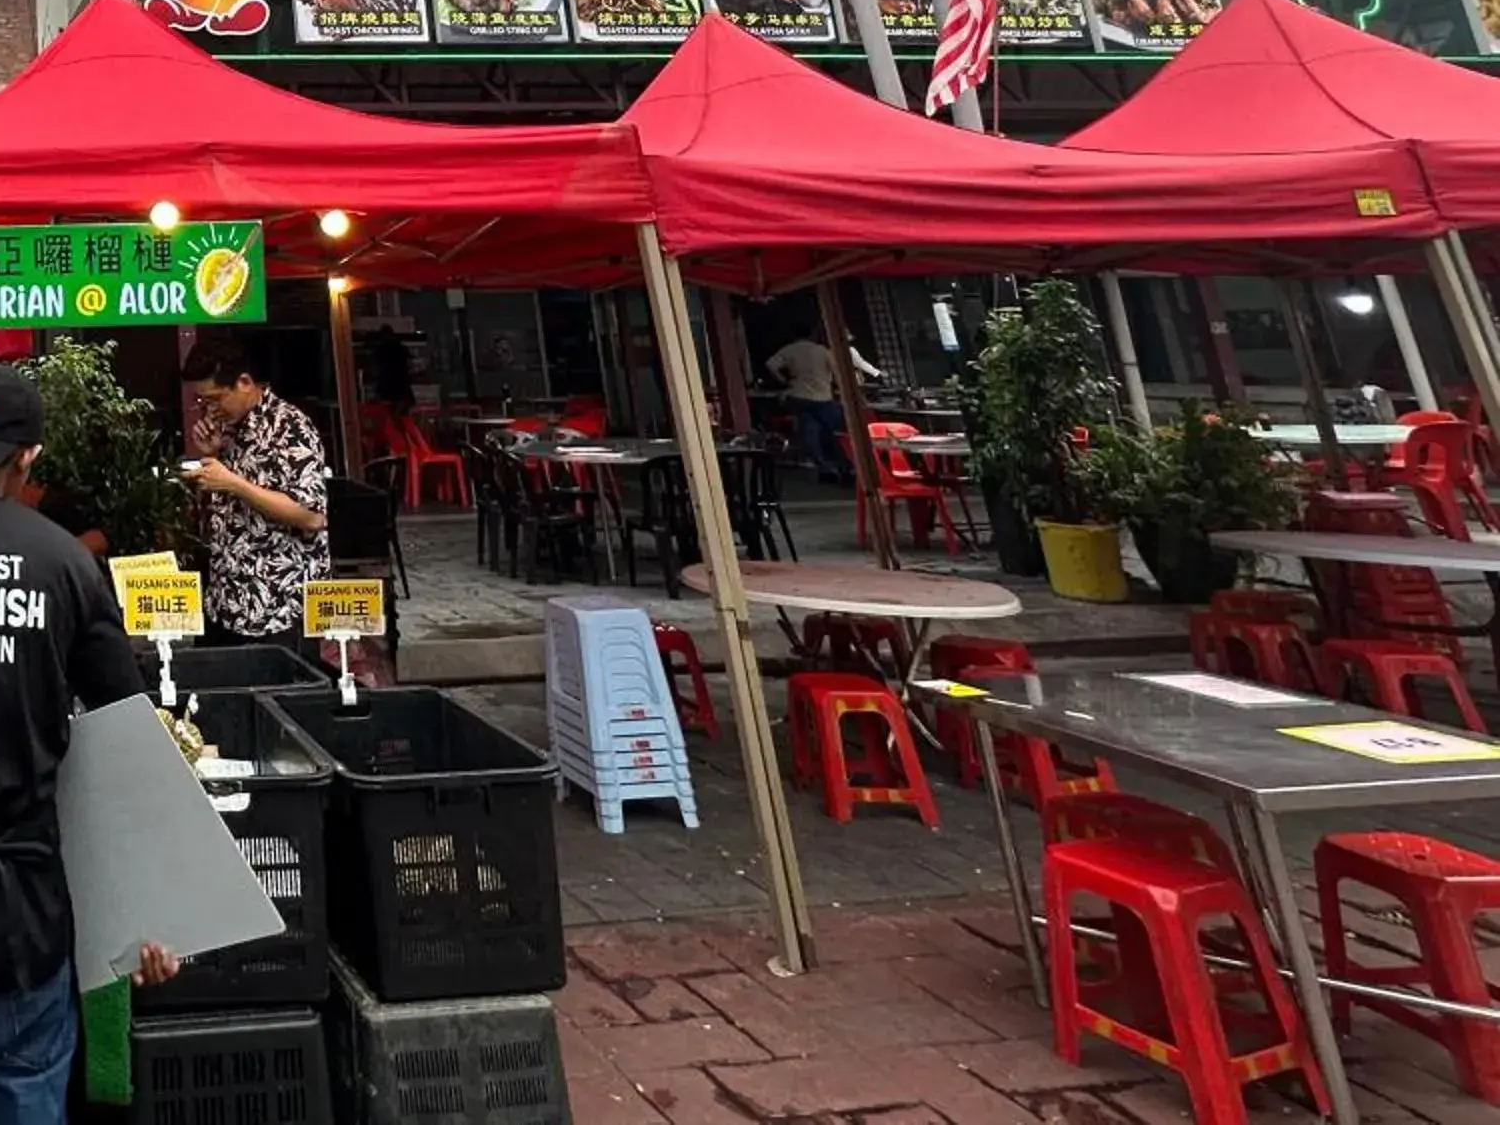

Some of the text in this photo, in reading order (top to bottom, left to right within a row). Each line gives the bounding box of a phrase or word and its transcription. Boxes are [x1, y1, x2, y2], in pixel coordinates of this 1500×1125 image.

[75, 283, 107, 316] @
[118, 280, 188, 316] ALOR
[126, 578, 197, 589] MUSANG KING
[307, 586, 379, 596] MUSANG KING
